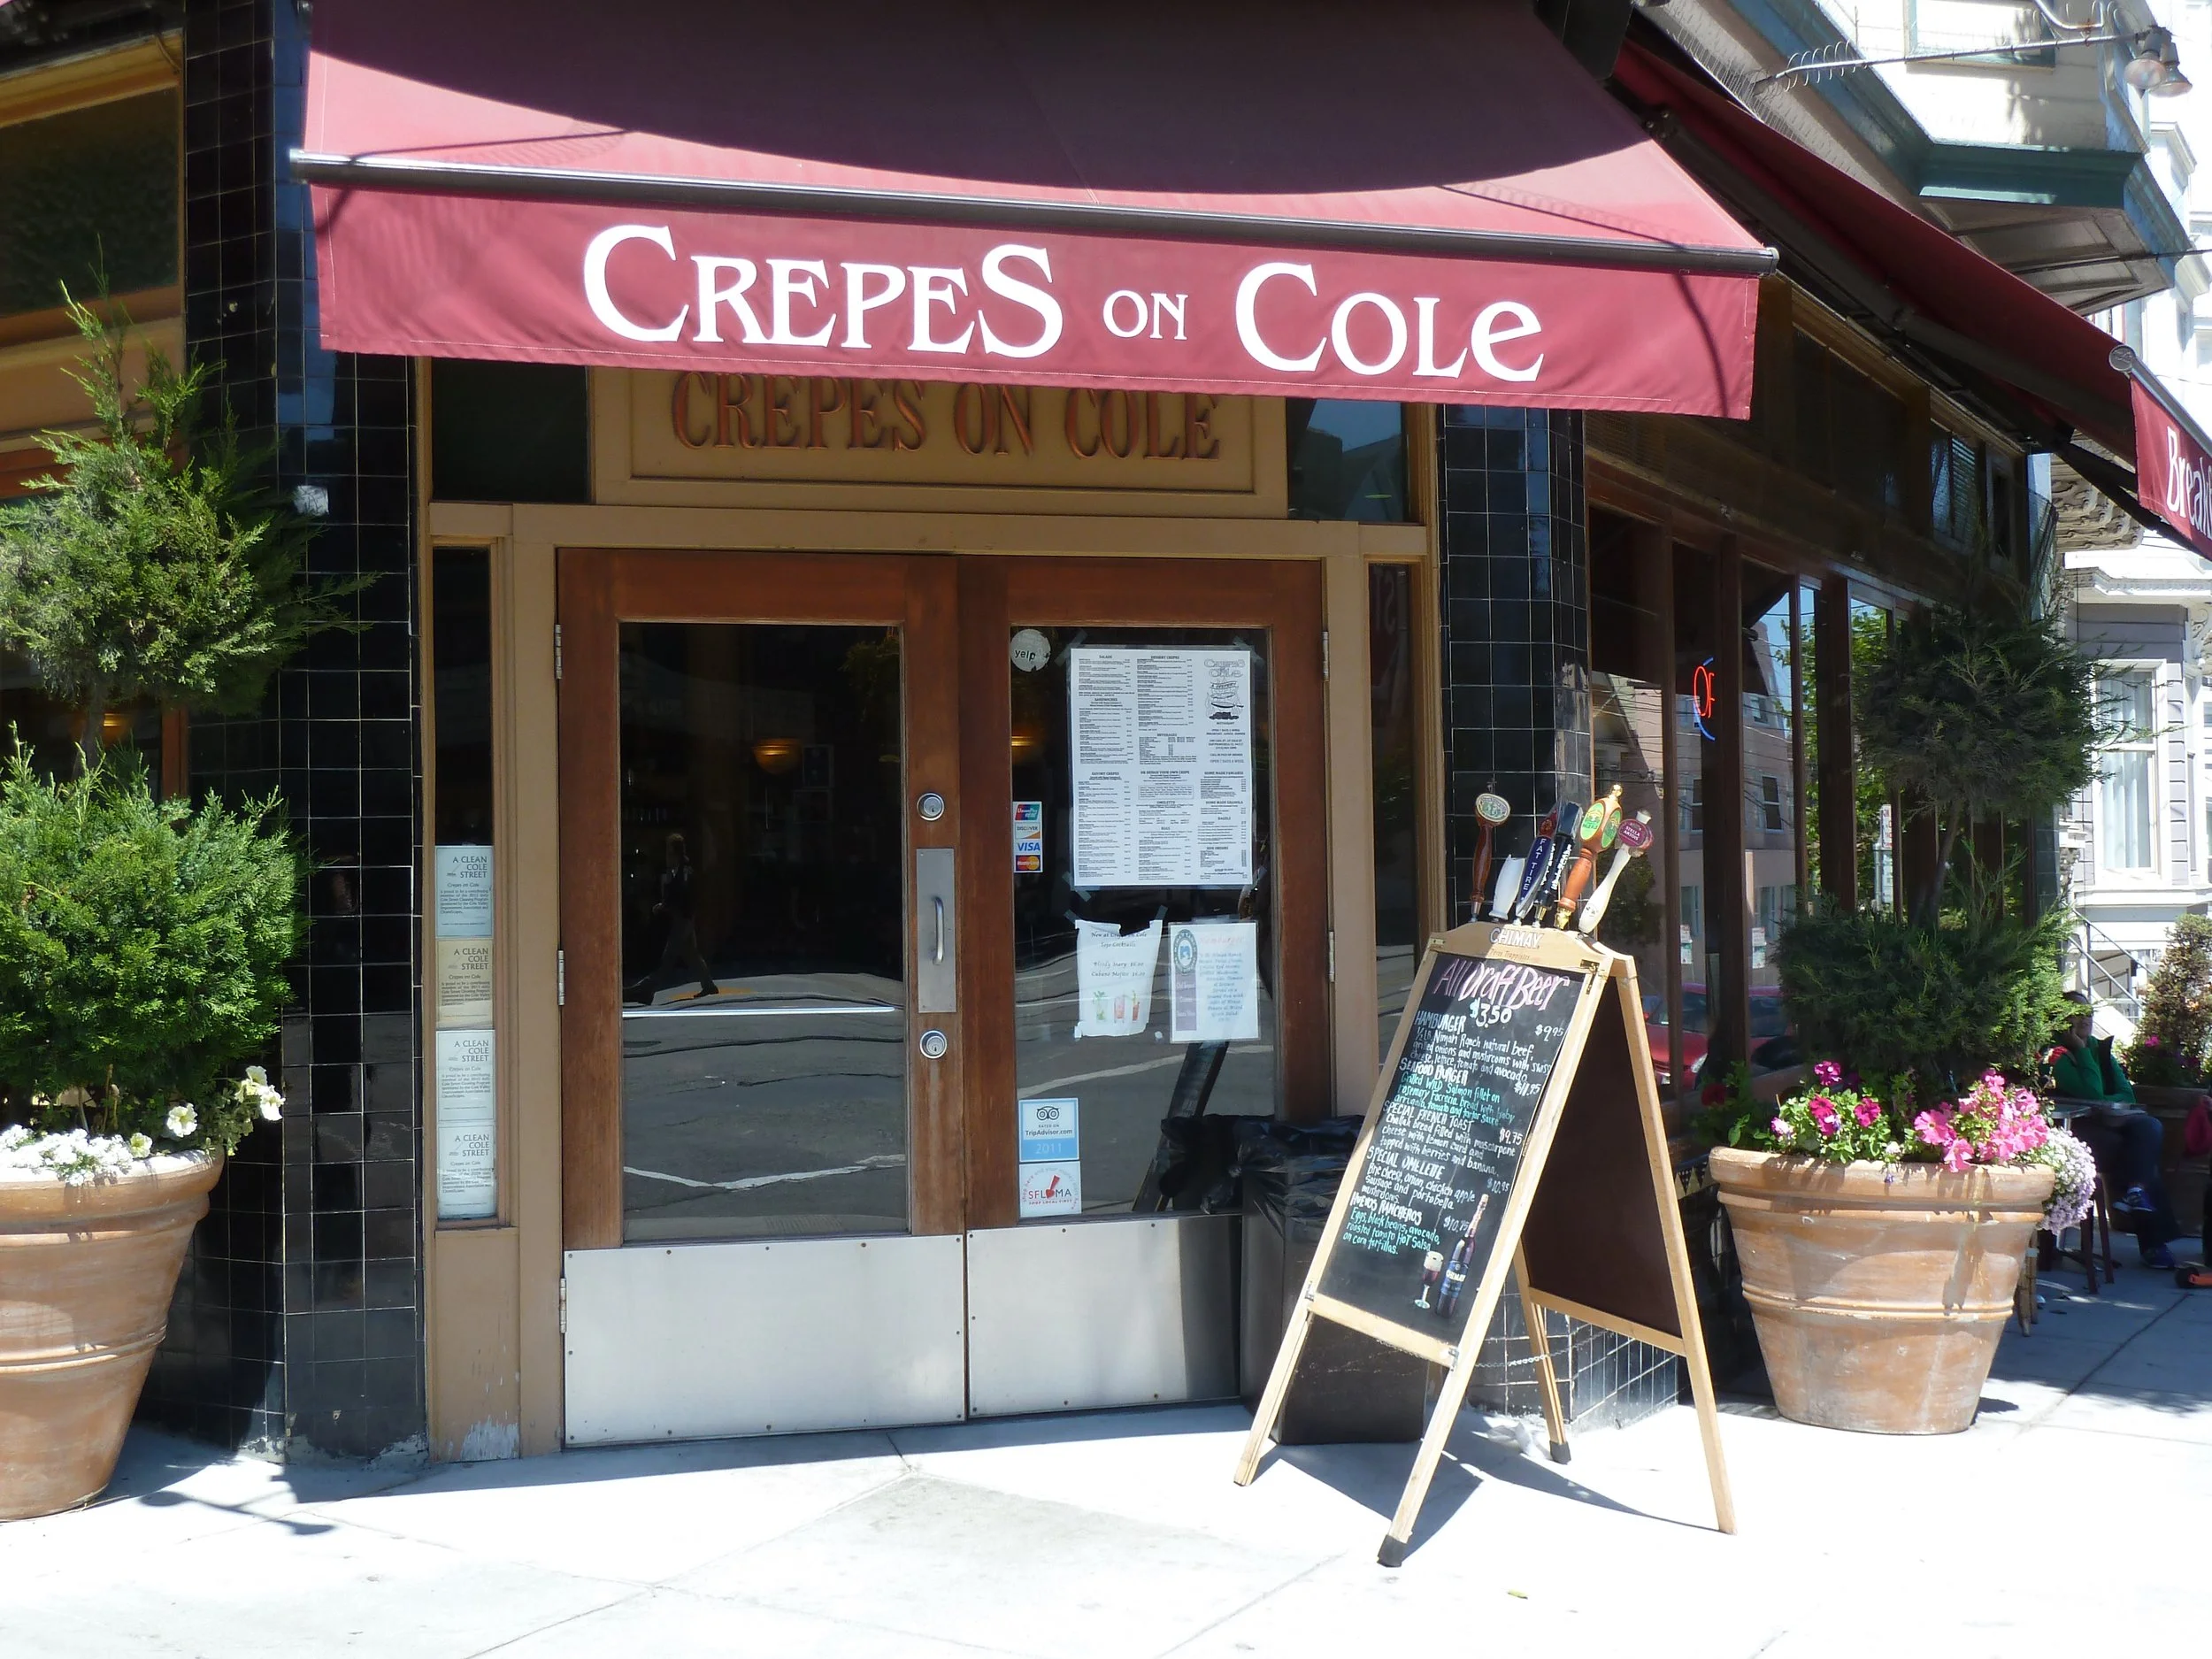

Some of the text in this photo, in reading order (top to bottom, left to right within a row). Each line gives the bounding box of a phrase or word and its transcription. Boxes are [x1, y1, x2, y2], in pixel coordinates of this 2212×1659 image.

[583, 225, 1064, 358] CREPES
[1103, 289, 1187, 341] ON
[672, 372, 1221, 461] CREPES ON COLE
[1015, 649, 1036, 661] yelp
[1018, 842, 1041, 851] VISA
[1625, 826, 1640, 837] STELLA
[1524, 838, 1548, 890] FAT TIRE
[1490, 927, 1544, 949] CHIMAY
[1433, 958, 1570, 1011] All Draft Beer
[1414, 1010, 1466, 1034] HAMBURGER
[1469, 997, 1512, 1028] $3.50
[1435, 1045, 1456, 1056] onions
[1458, 1047, 1472, 1059] and
[1472, 1050, 1510, 1065] mushrooms
[1512, 1057, 1530, 1071] with
[1459, 1033, 1481, 1048] Ranch
[1483, 1038, 1510, 1052] natural
[1399, 1057, 1433, 1076] SEAFOOD
[1434, 1064, 1469, 1086] BURGER
[1457, 1056, 1479, 1072] tomato
[1481, 1064, 1494, 1075] and
[1397, 1084, 1430, 1102] rosemary
[1459, 1096, 1479, 1110] bread
[1480, 1104, 1494, 1115] with
[1401, 1071, 1501, 1103] Grilled WILD Salmon fillet on
[1383, 1100, 1523, 1146] SPECIAL FRENCH TOAST $9.75
[1427, 1101, 1449, 1113] tomato
[1450, 1106, 1463, 1118] and
[1036, 1142, 1062, 1154] 2011
[1380, 1135, 1404, 1150] topped
[1404, 1142, 1421, 1155] with
[1421, 1144, 1451, 1162] berries
[1451, 1154, 1467, 1166] and
[1382, 1125, 1485, 1160] cheese with lemon curd and
[1412, 1118, 1434, 1133] bread
[1433, 1124, 1455, 1139] filled
[1455, 1132, 1471, 1145] with
[1473, 1139, 1516, 1158] mascarpone
[1366, 1145, 1510, 1194] SPECIAL OMELETTE $10.95
[1367, 1162, 1476, 1204] Brie cheese, onion, chicken apple
[1349, 1191, 1378, 1211] HUEVOS
[1378, 1199, 1423, 1226] RANCHEROS
[1394, 1183, 1409, 1194] and
[1408, 1188, 1455, 1210] portobella
[1346, 1222, 1371, 1236] roasted
[1371, 1227, 1395, 1241] tomato
[1411, 1236, 1432, 1252] Salsa
[1350, 1206, 1440, 1246] Eggs, black beans, avocado,
[1343, 1232, 1399, 1255] on corn tortillas.
